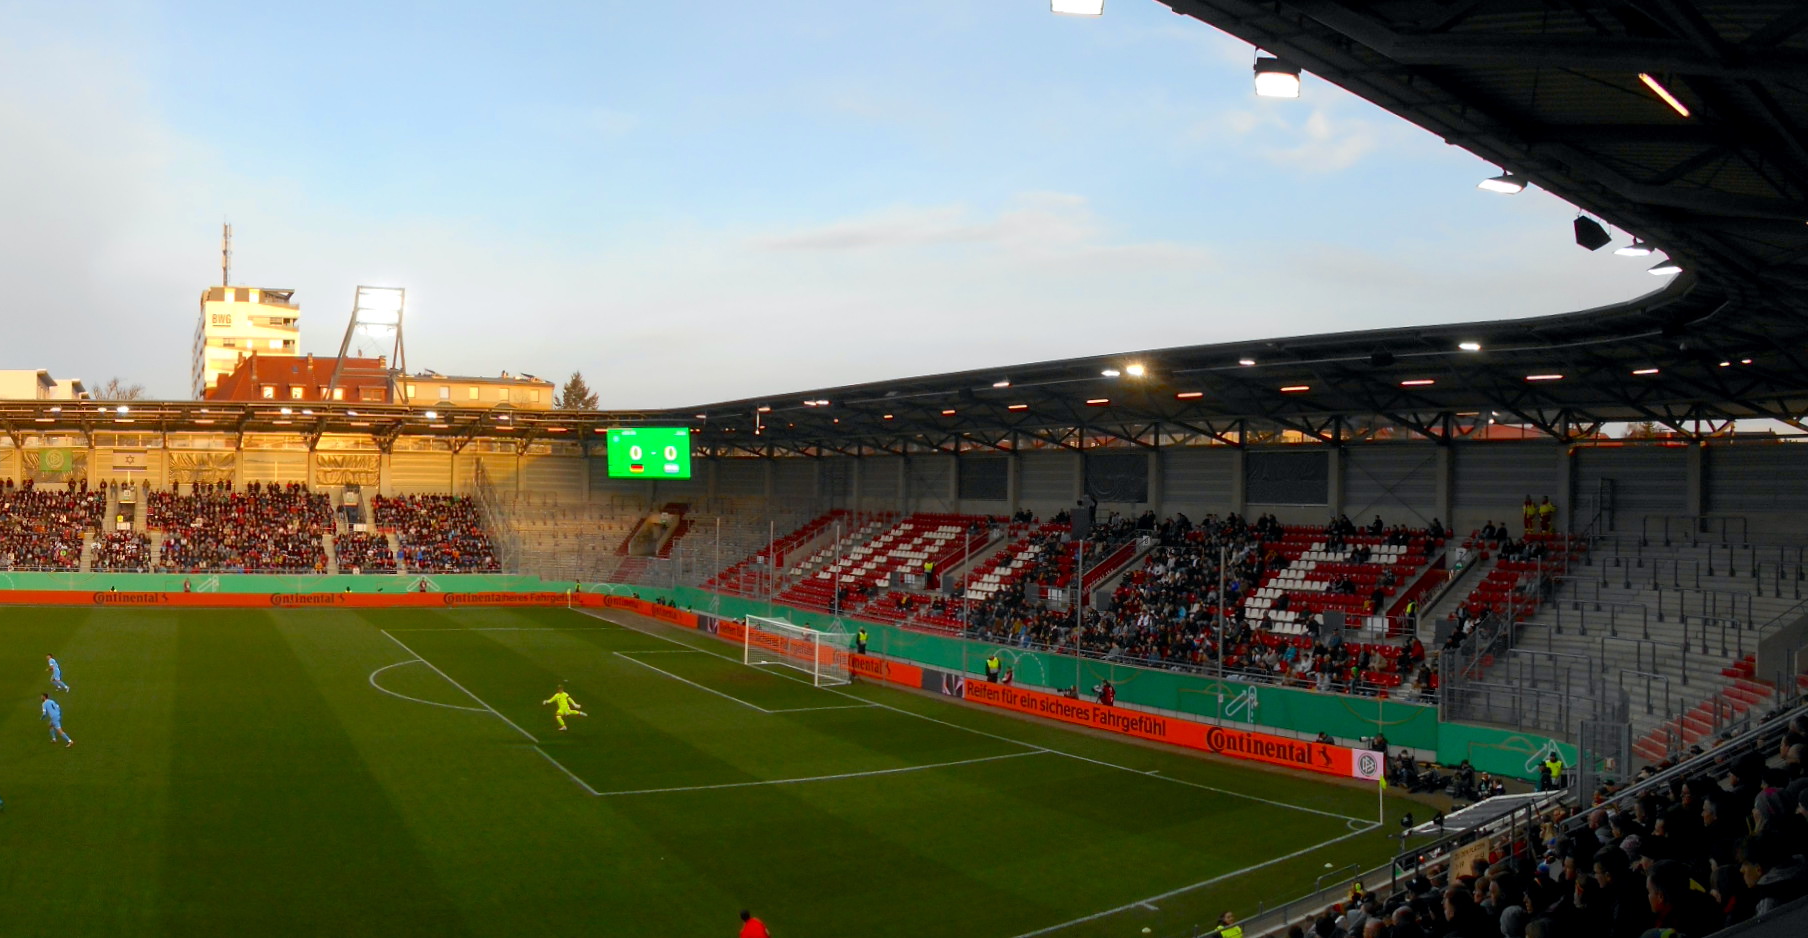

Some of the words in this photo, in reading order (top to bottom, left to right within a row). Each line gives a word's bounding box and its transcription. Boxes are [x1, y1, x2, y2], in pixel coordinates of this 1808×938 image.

[212, 314, 231, 324] BWG
[93, 592, 159, 605] Continental
[270, 592, 335, 606] Continental
[967, 681, 1000, 702] Reifen
[1002, 688, 1018, 706] für
[1021, 693, 1038, 710] ein
[1040, 698, 1090, 721] sicheres
[1092, 707, 1167, 737] Fahrgefühl
[1206, 726, 1313, 765] Continental
